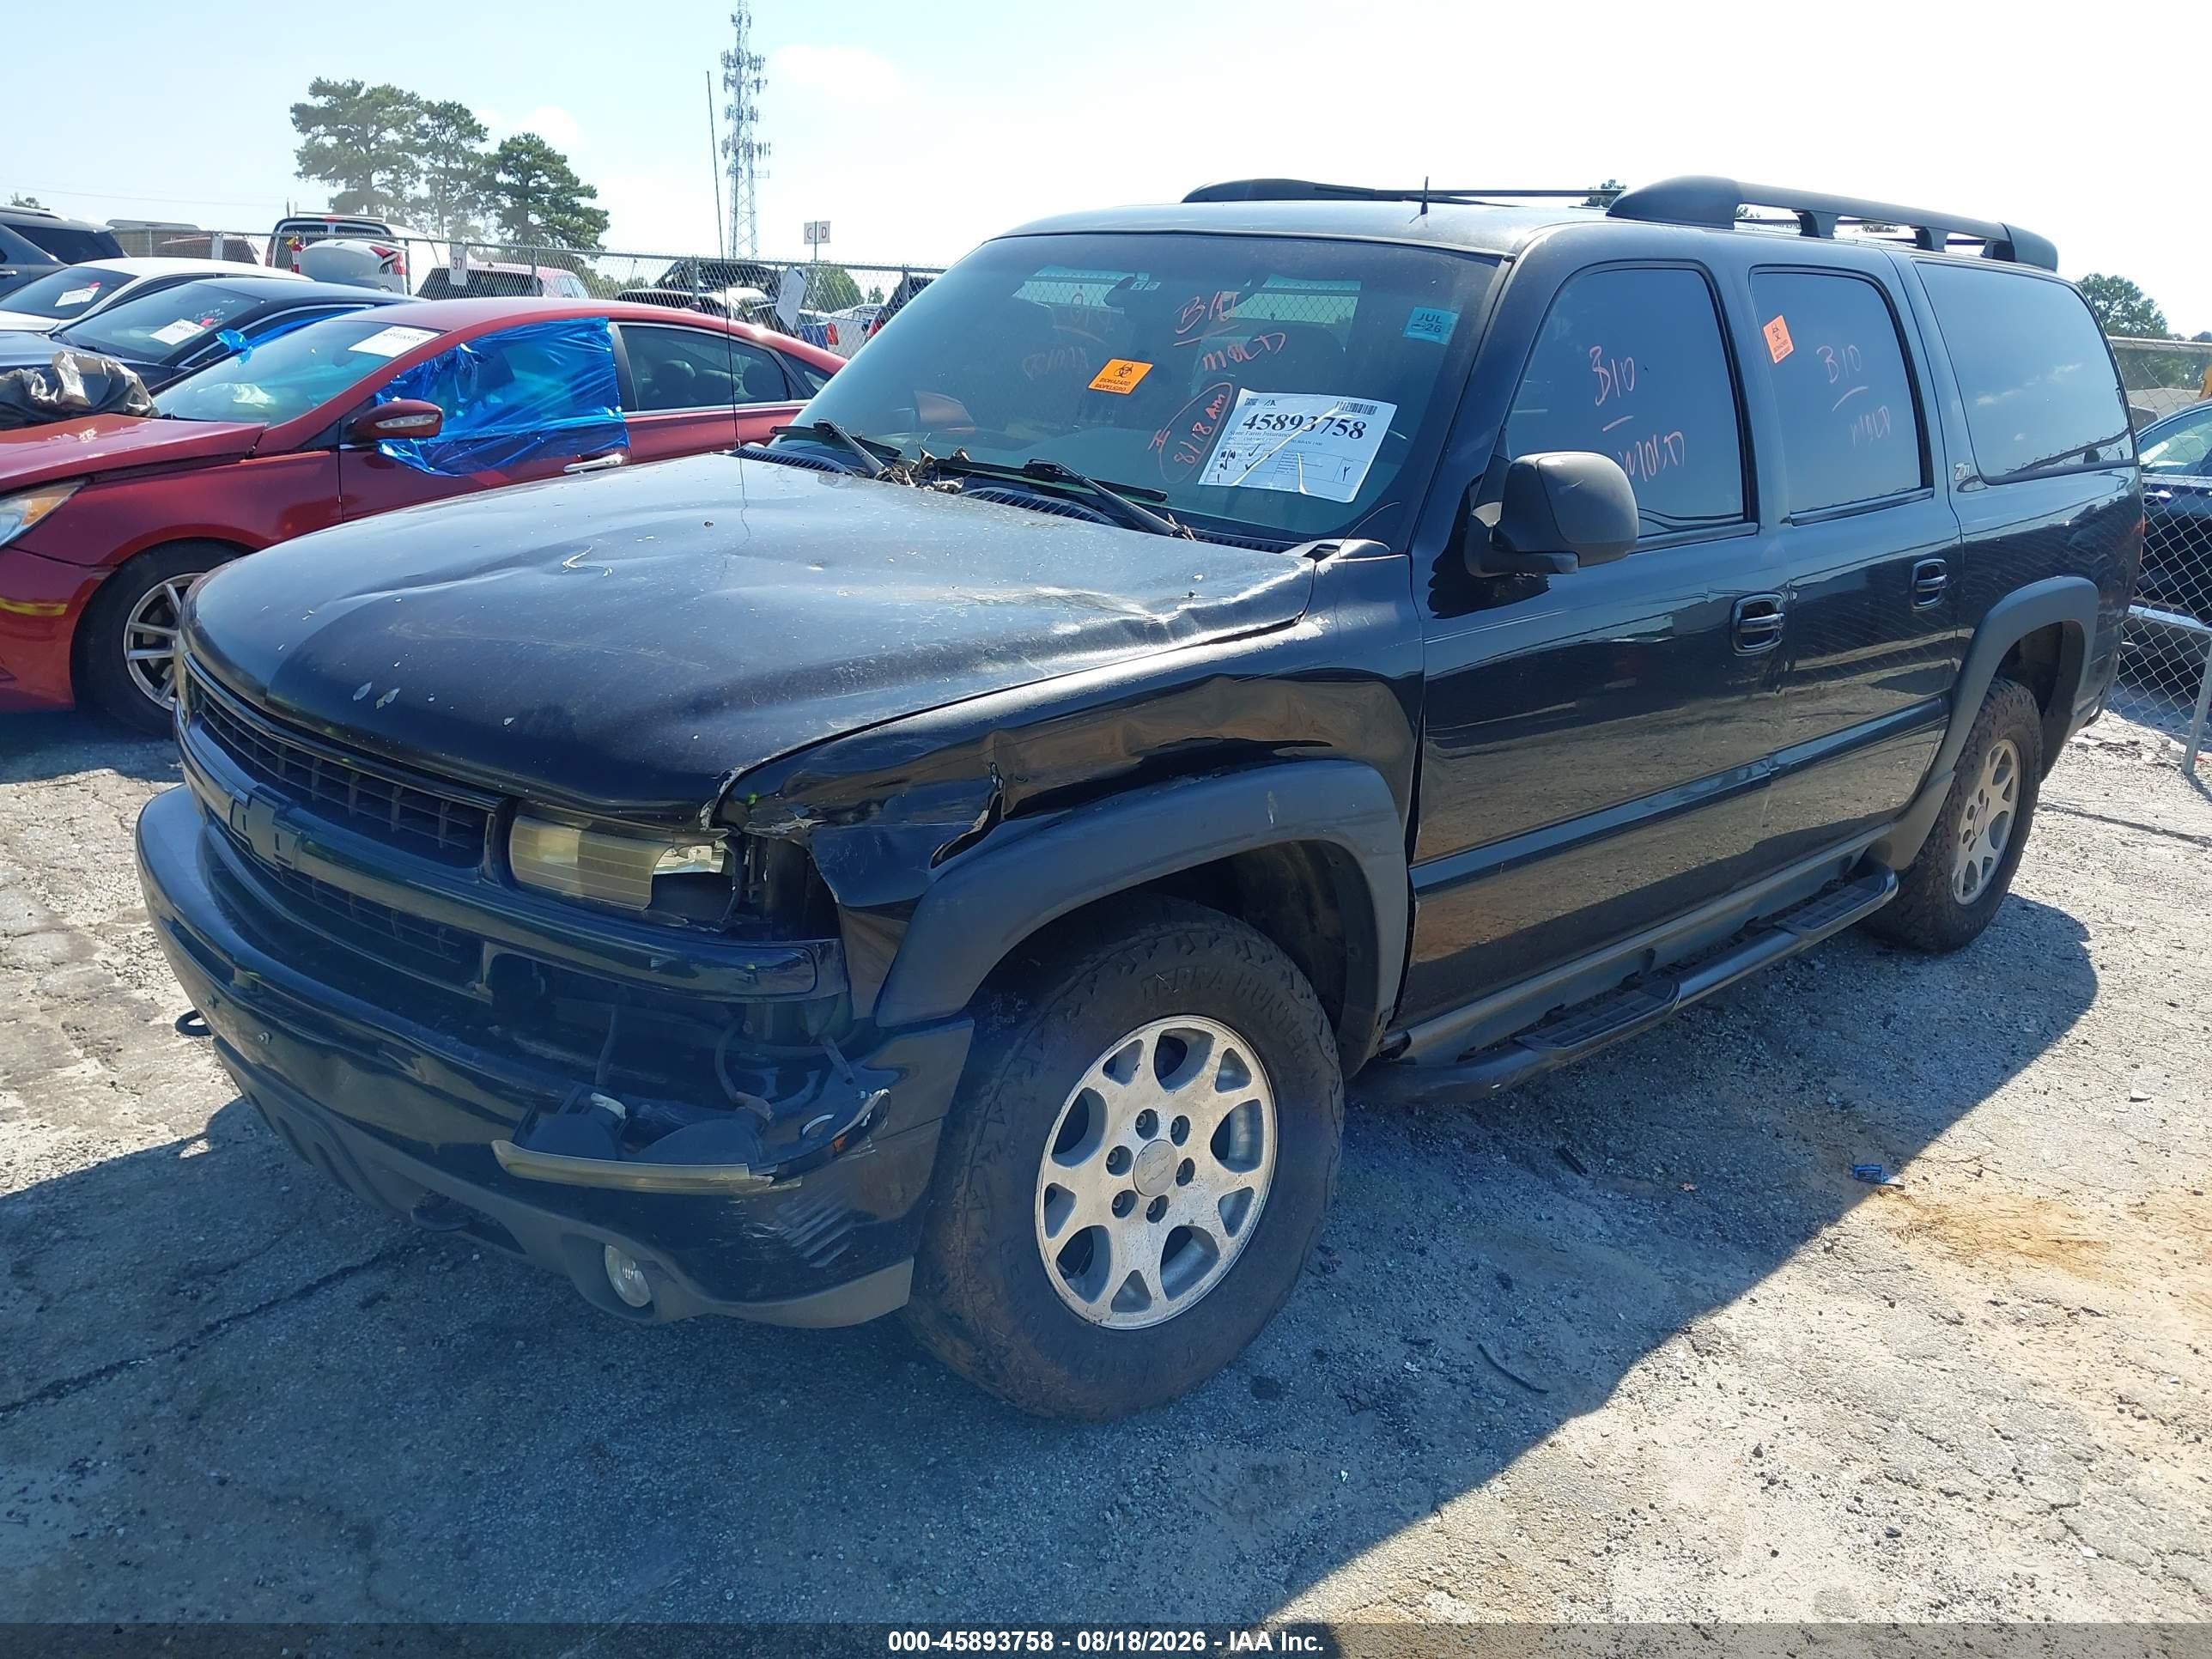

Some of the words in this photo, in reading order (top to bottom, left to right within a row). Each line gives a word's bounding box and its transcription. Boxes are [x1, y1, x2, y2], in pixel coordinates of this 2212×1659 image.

[821, 226, 827, 239] D
[453, 257, 463, 270] 37
[1416, 313, 1443, 325] JUL
[1425, 323, 1443, 333] 26
[1243, 412, 1367, 440] 45893758
